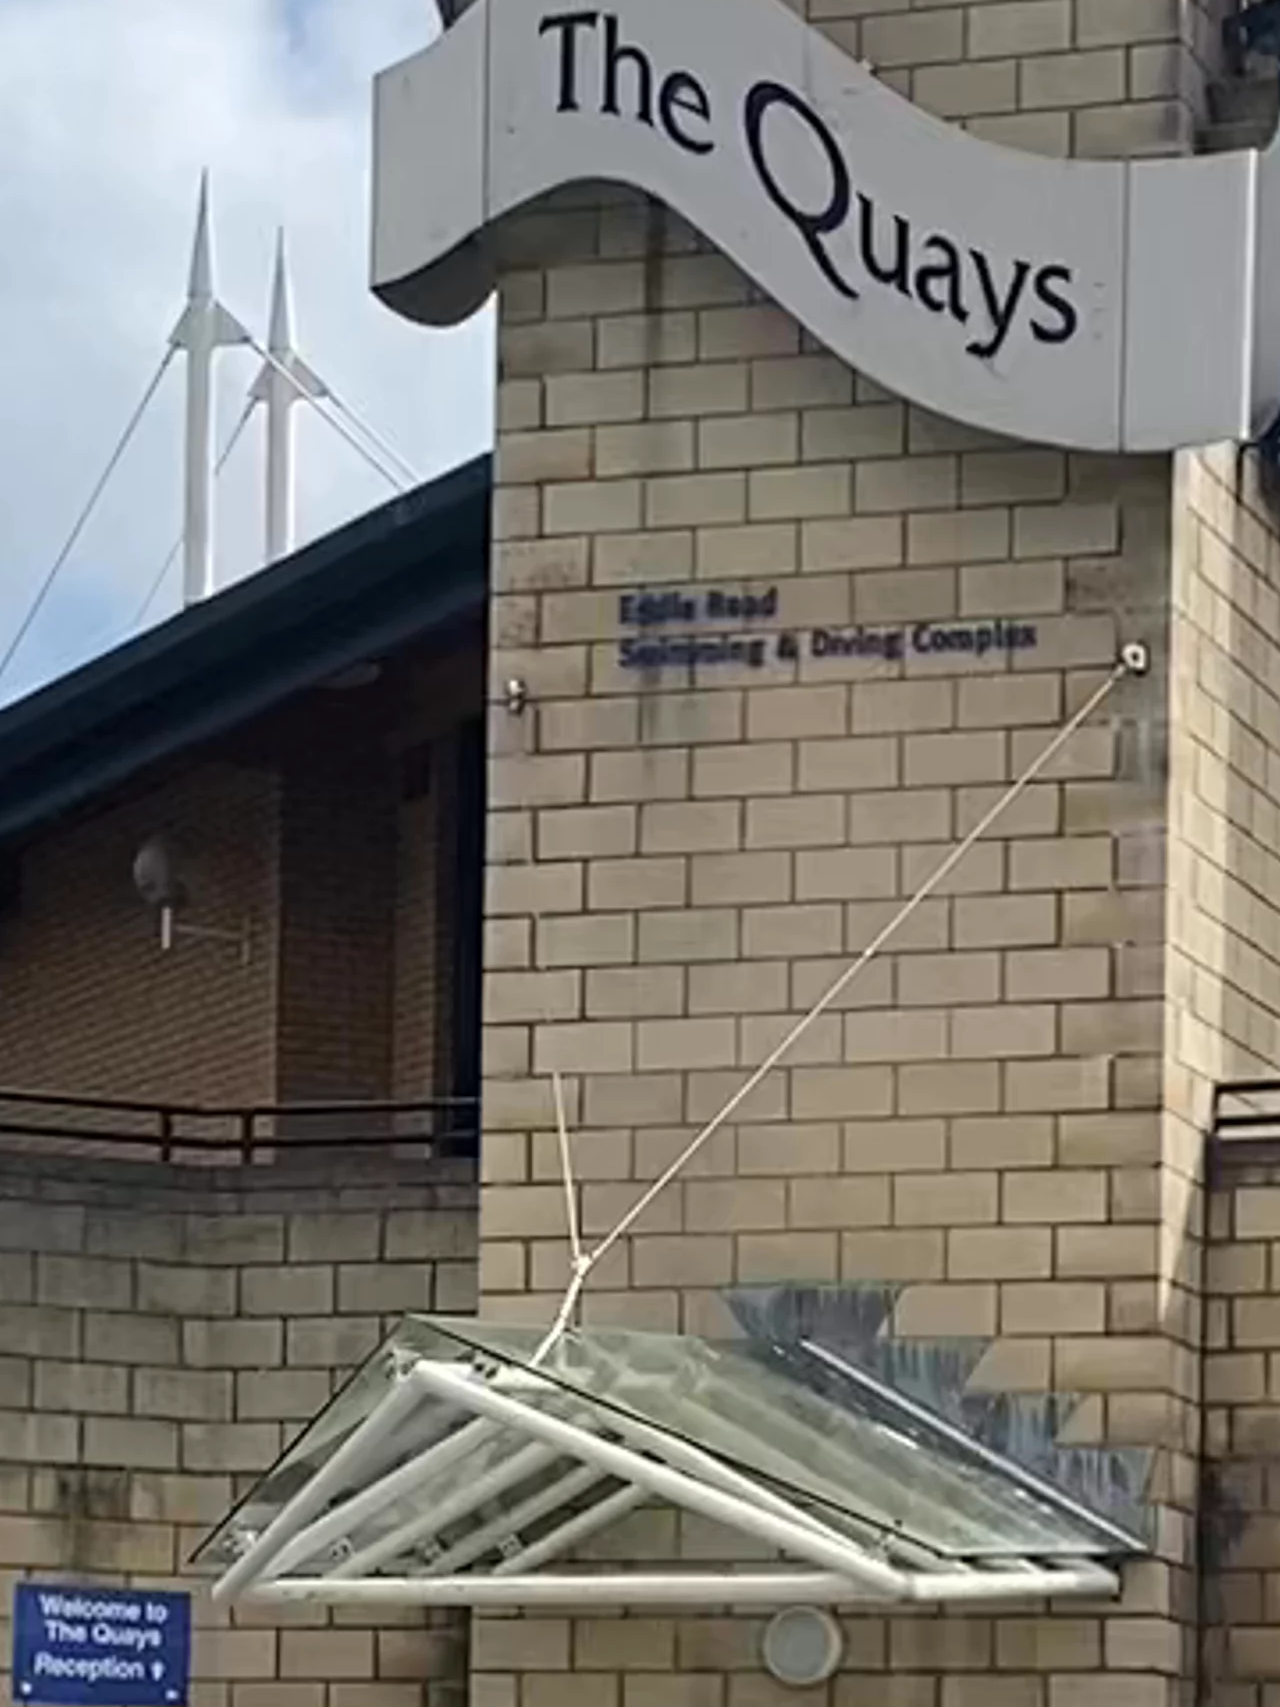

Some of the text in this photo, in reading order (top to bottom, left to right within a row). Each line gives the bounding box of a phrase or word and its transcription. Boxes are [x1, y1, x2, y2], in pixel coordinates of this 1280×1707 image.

[538, 11, 1077, 360] The Quays
[707, 585, 778, 619] Read
[618, 619, 1038, 668] Swimming & Diving Complex
[37, 1593, 169, 1624] Welcome to
[43, 1618, 162, 1652] The Quays
[33, 1651, 145, 1683] Reception
